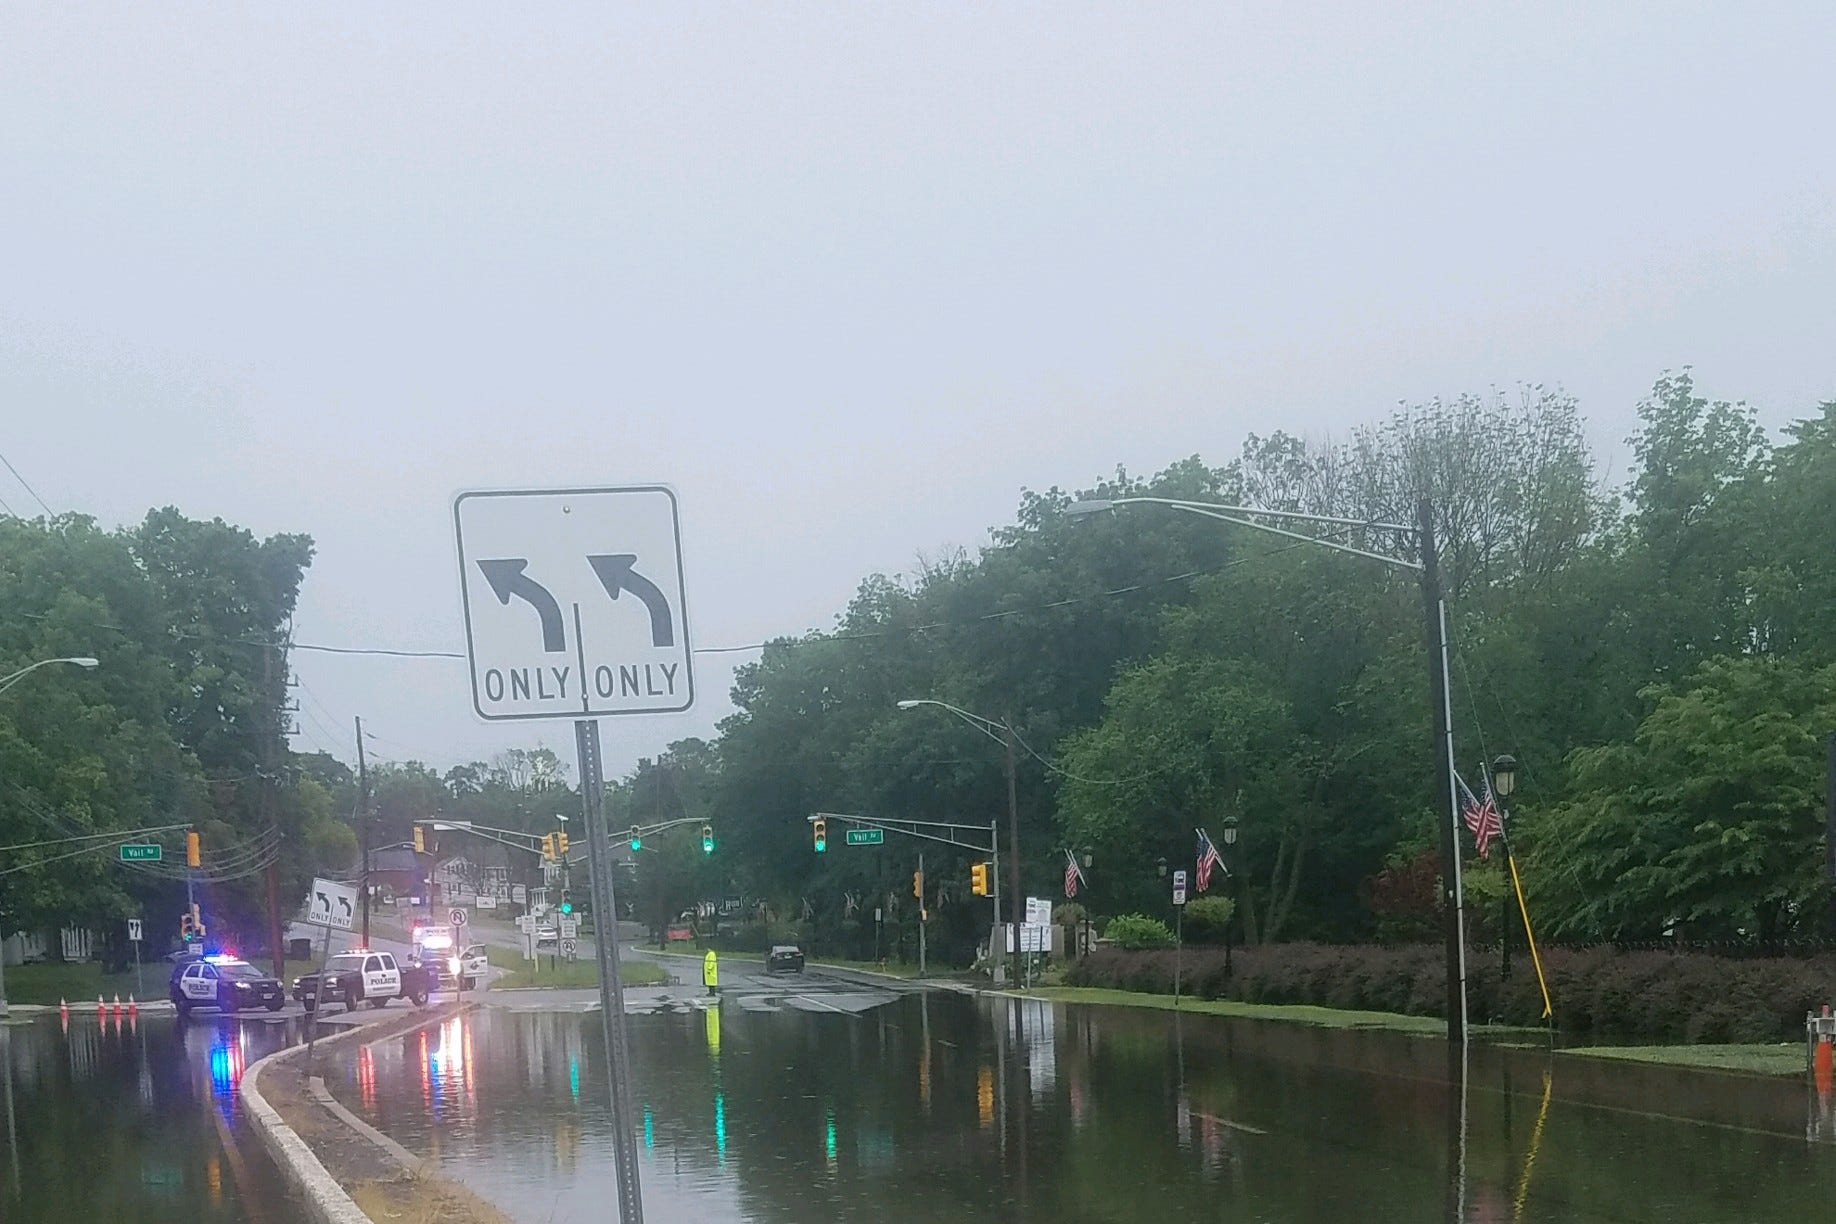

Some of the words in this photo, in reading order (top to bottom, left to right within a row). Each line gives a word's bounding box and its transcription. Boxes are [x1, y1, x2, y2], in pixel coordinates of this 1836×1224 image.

[485, 666, 570, 702] ONLY
[595, 662, 679, 698] ONLY
[310, 912, 330, 922] ONLY
[332, 917, 350, 926] ONLY
